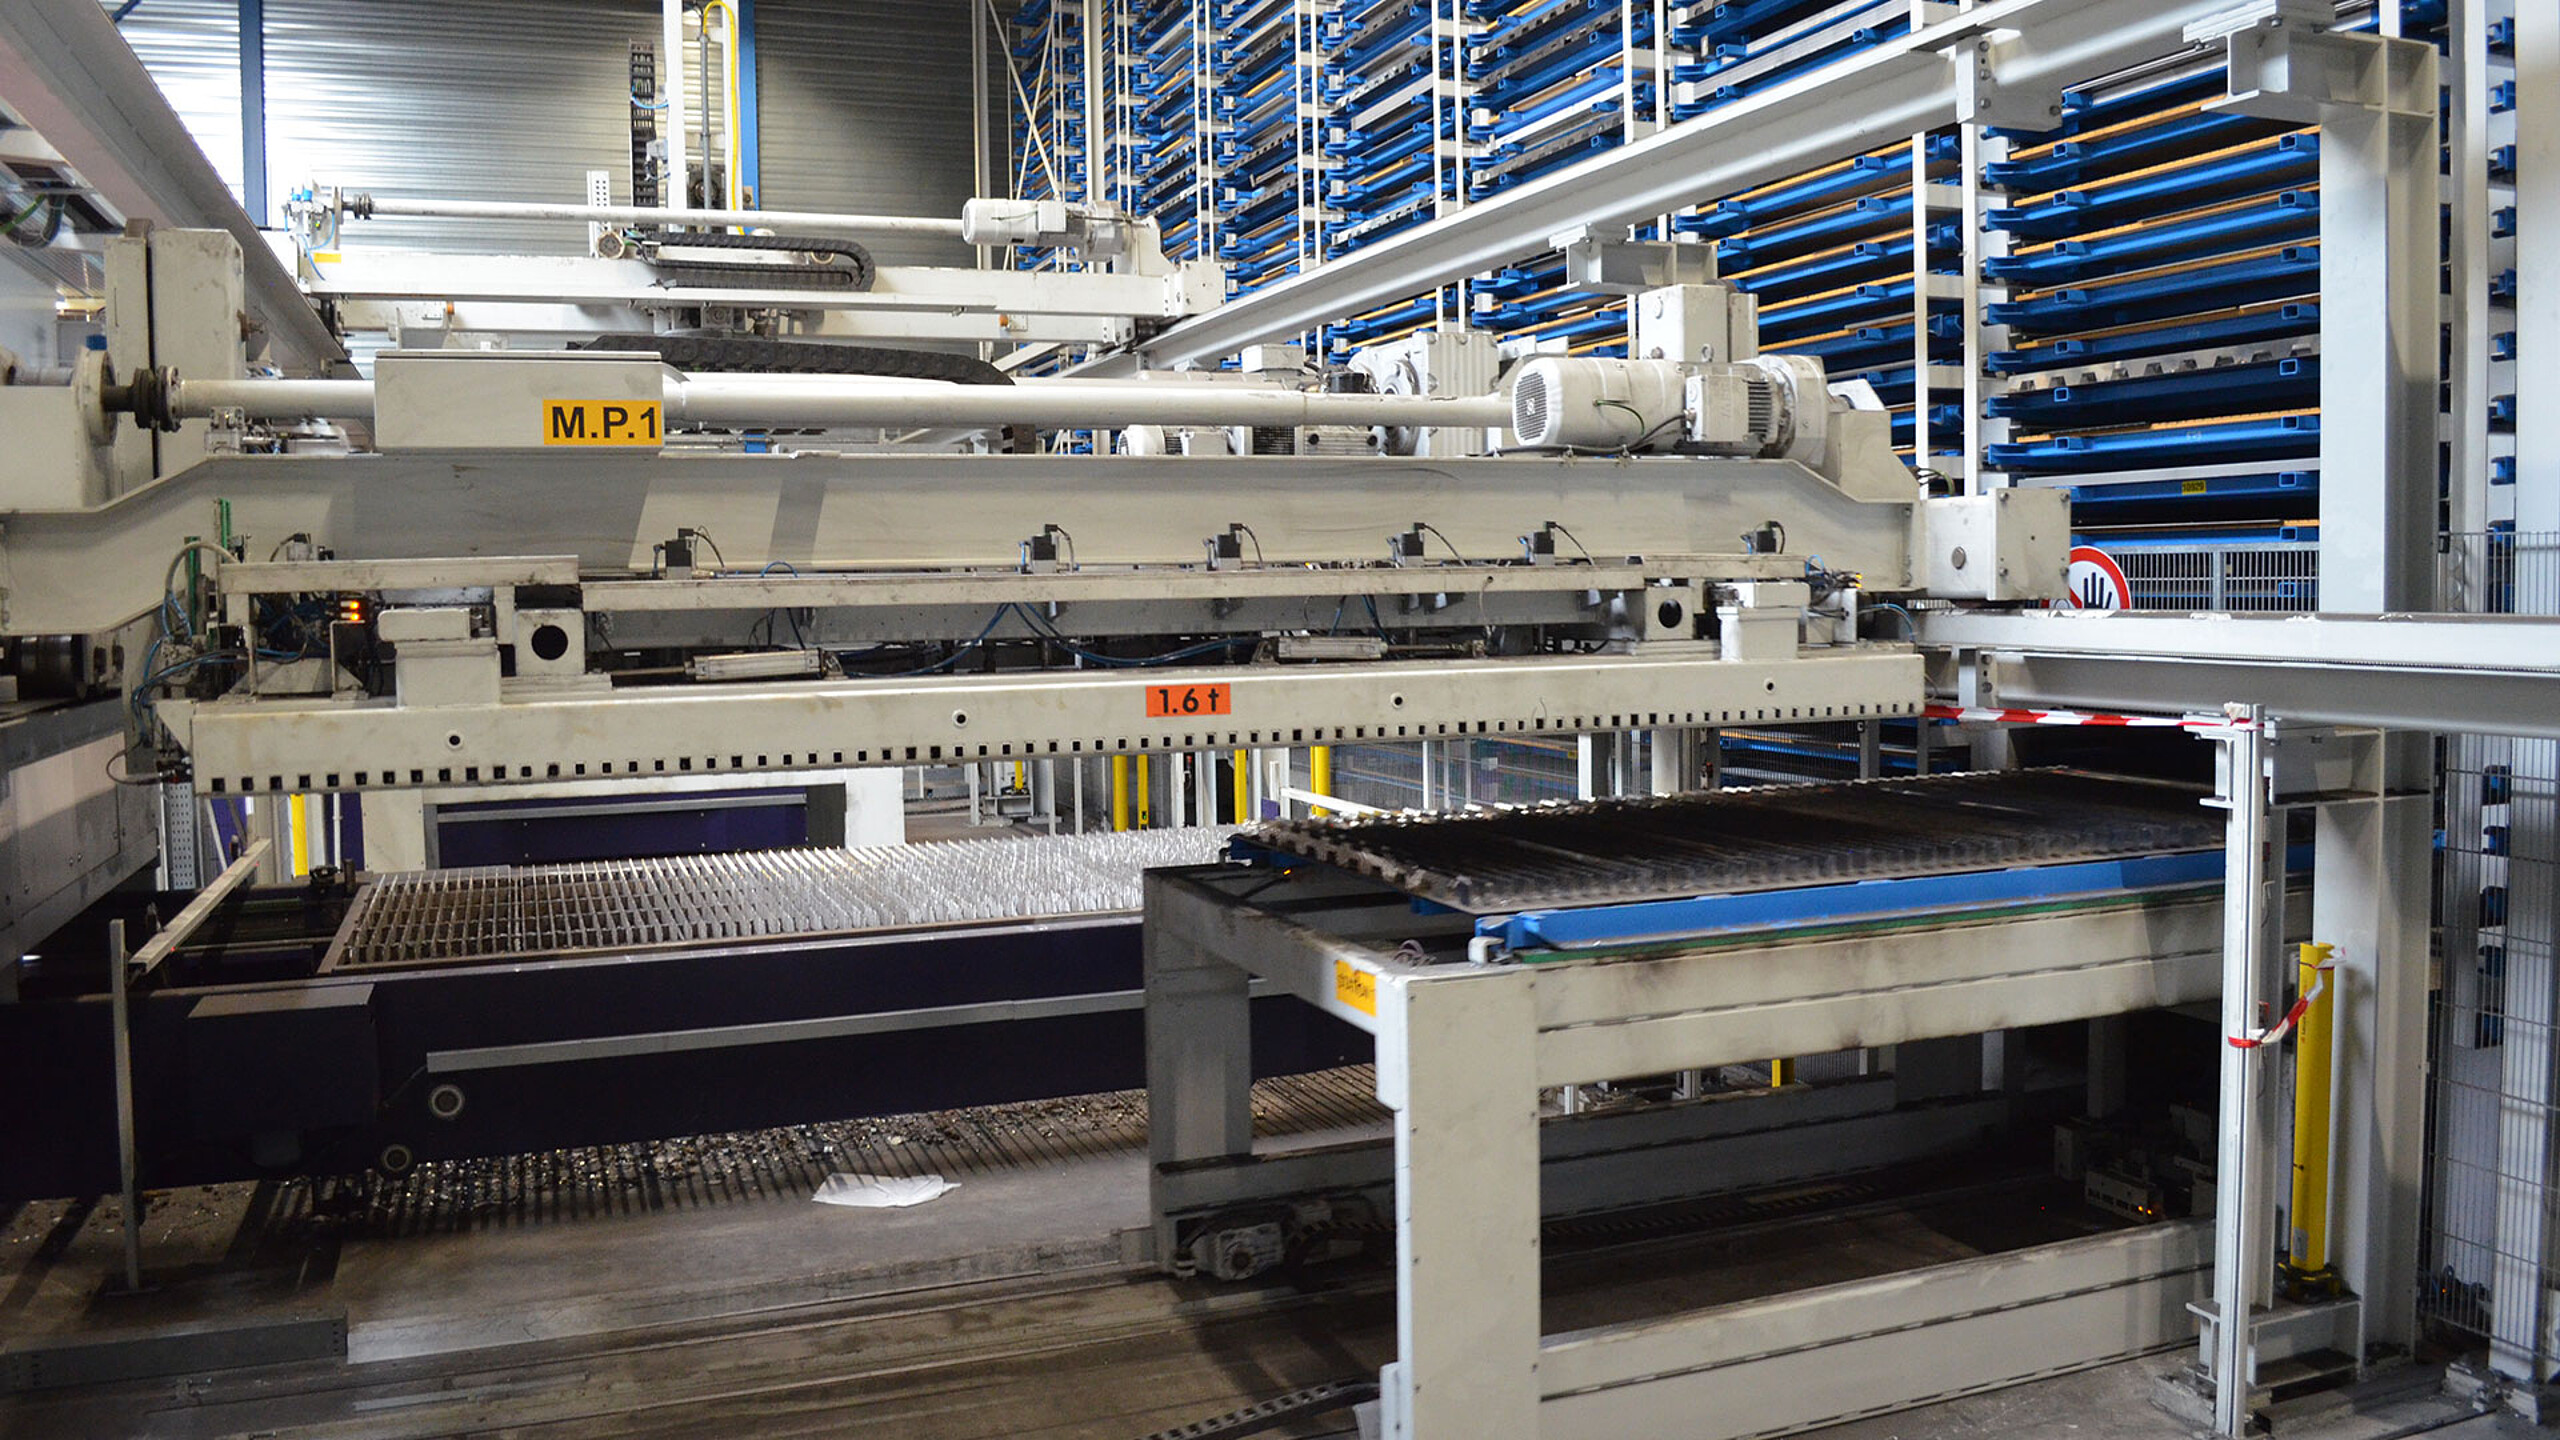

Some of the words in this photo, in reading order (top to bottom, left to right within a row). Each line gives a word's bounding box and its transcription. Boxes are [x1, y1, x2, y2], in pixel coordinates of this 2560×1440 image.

[551, 406, 656, 439] M.P.1
[1158, 688, 1199, 714] 1.6
[1208, 688, 1219, 712] t
